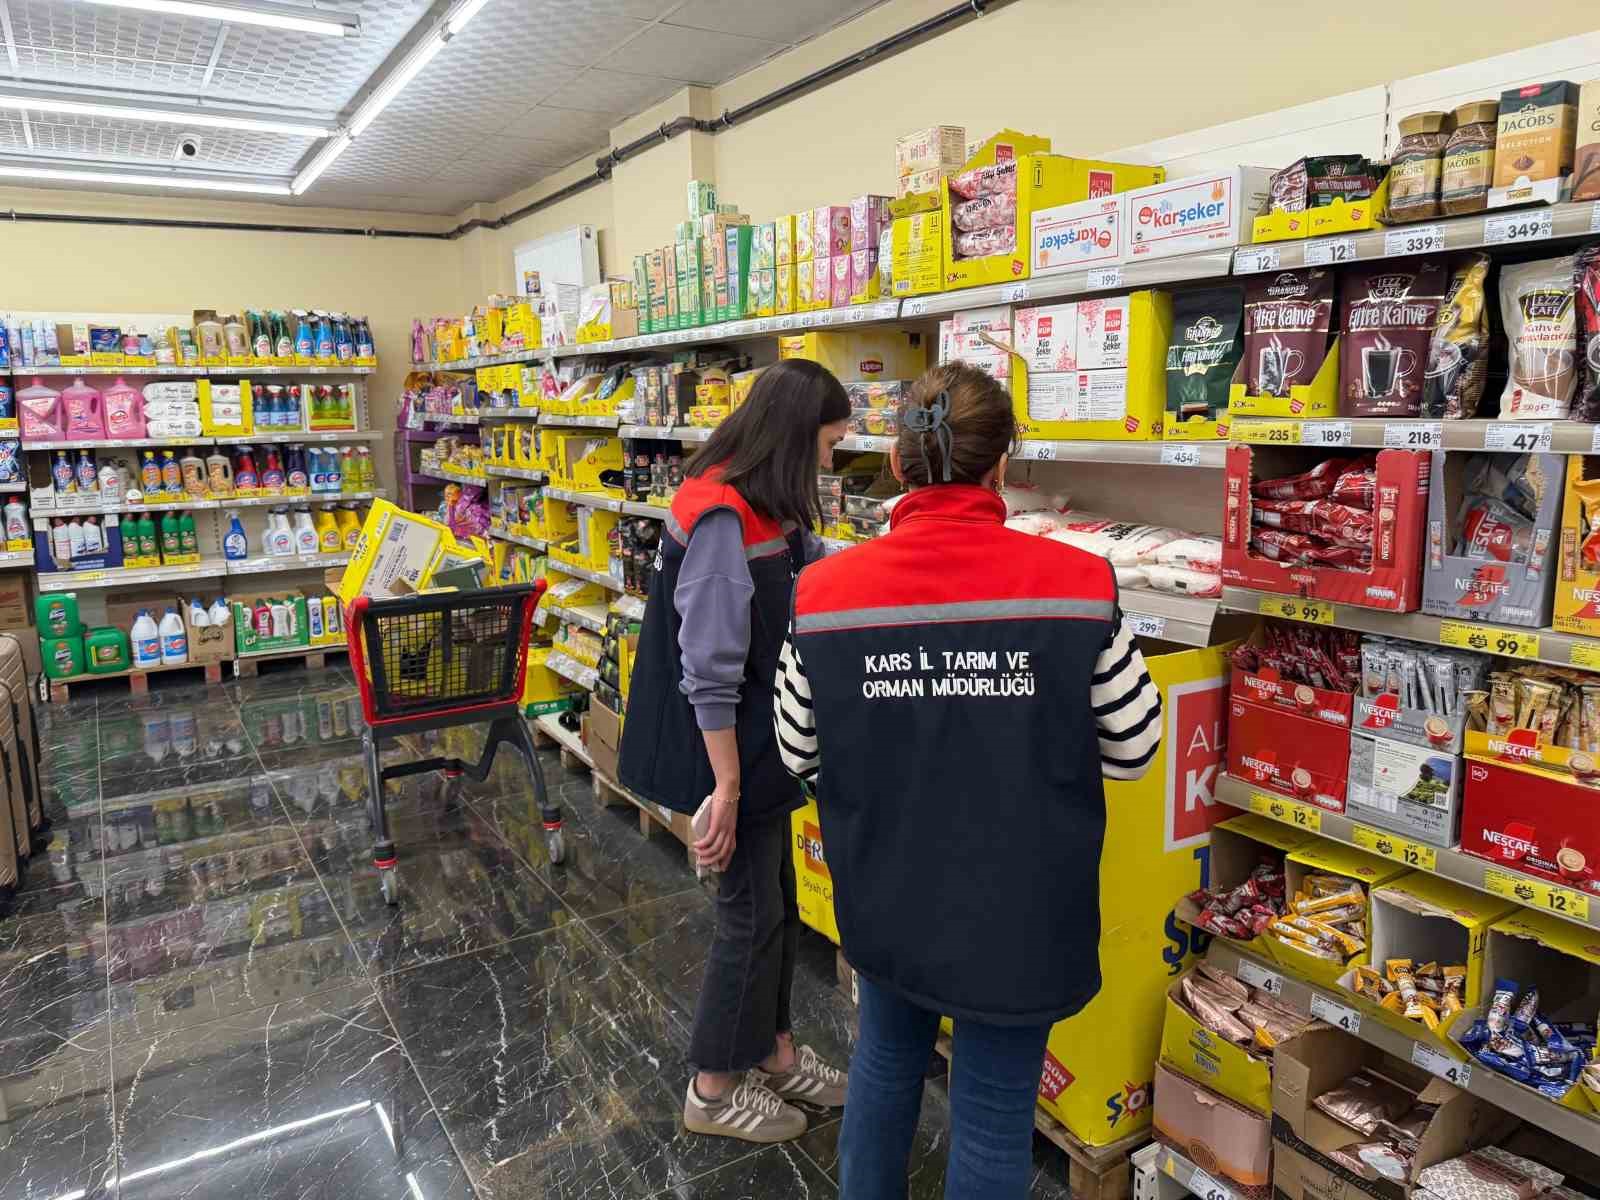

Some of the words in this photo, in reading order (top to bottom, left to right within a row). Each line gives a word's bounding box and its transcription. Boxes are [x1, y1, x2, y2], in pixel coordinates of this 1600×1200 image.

[1501, 113, 1555, 134] JACOBS
[1446, 156, 1480, 169] JACOBS
[1153, 201, 1226, 229] karşeker
[1039, 226, 1098, 250] karşeker
[1278, 307, 1316, 327] Kahve
[1382, 306, 1427, 327] Kahve
[1269, 430, 1289, 441] 235
[1321, 430, 1342, 442] 189
[1037, 447, 1050, 460] 62
[1174, 452, 1193, 463] 454
[1301, 607, 1319, 621] 99
[1139, 622, 1157, 633] 299
[1496, 639, 1519, 655] 99
[864, 653, 913, 674] KARS
[919, 645, 934, 671] İL
[942, 651, 998, 671] TARIM
[1006, 651, 1030, 670] VE
[862, 678, 925, 699] ORMAN
[932, 672, 1036, 697] MÜDÜRLÜĞÜ
[1292, 811, 1306, 825] 12
[1403, 848, 1419, 865] 12
[1547, 892, 1567, 911] 12
